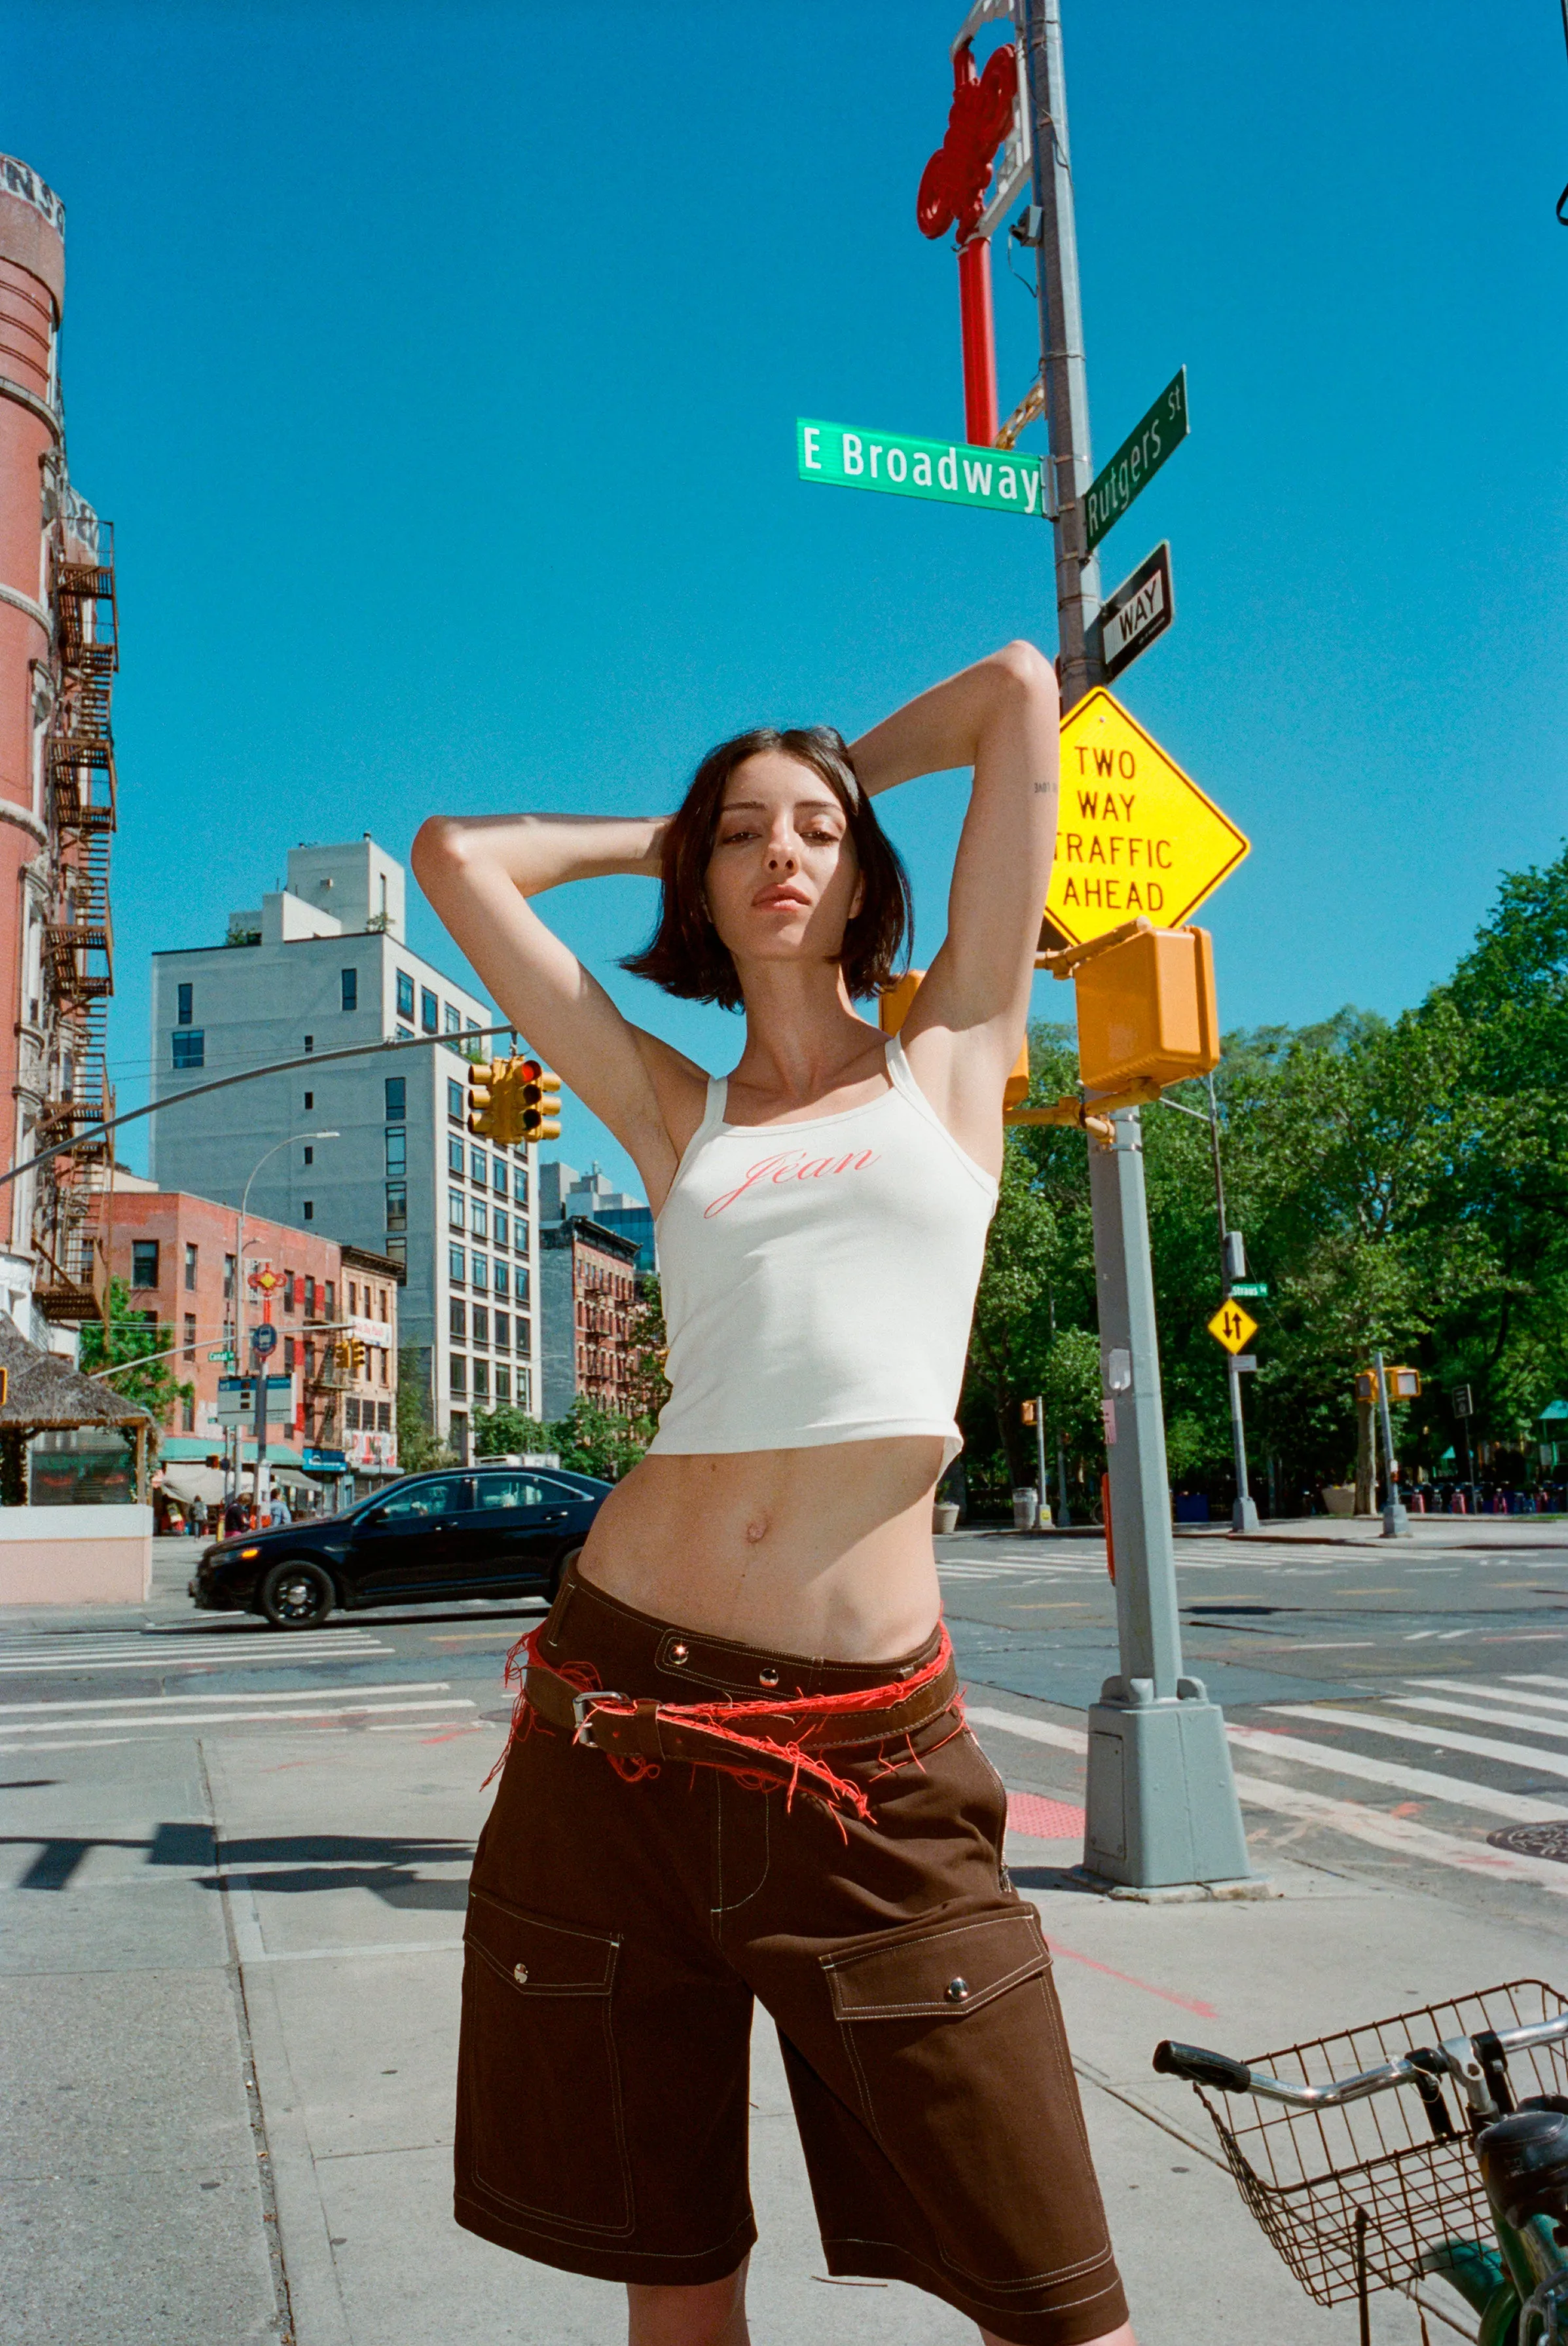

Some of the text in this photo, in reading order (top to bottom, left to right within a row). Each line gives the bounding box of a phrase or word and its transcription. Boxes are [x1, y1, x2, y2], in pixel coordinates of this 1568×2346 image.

[804, 427, 1040, 514] E Broadway
[1087, 420, 1161, 537] Rutgers
[1119, 579, 1157, 642] WAY
[1074, 746, 1135, 779] TWO
[1077, 790, 1135, 823] WAY
[1063, 877, 1163, 912] AHEAD
